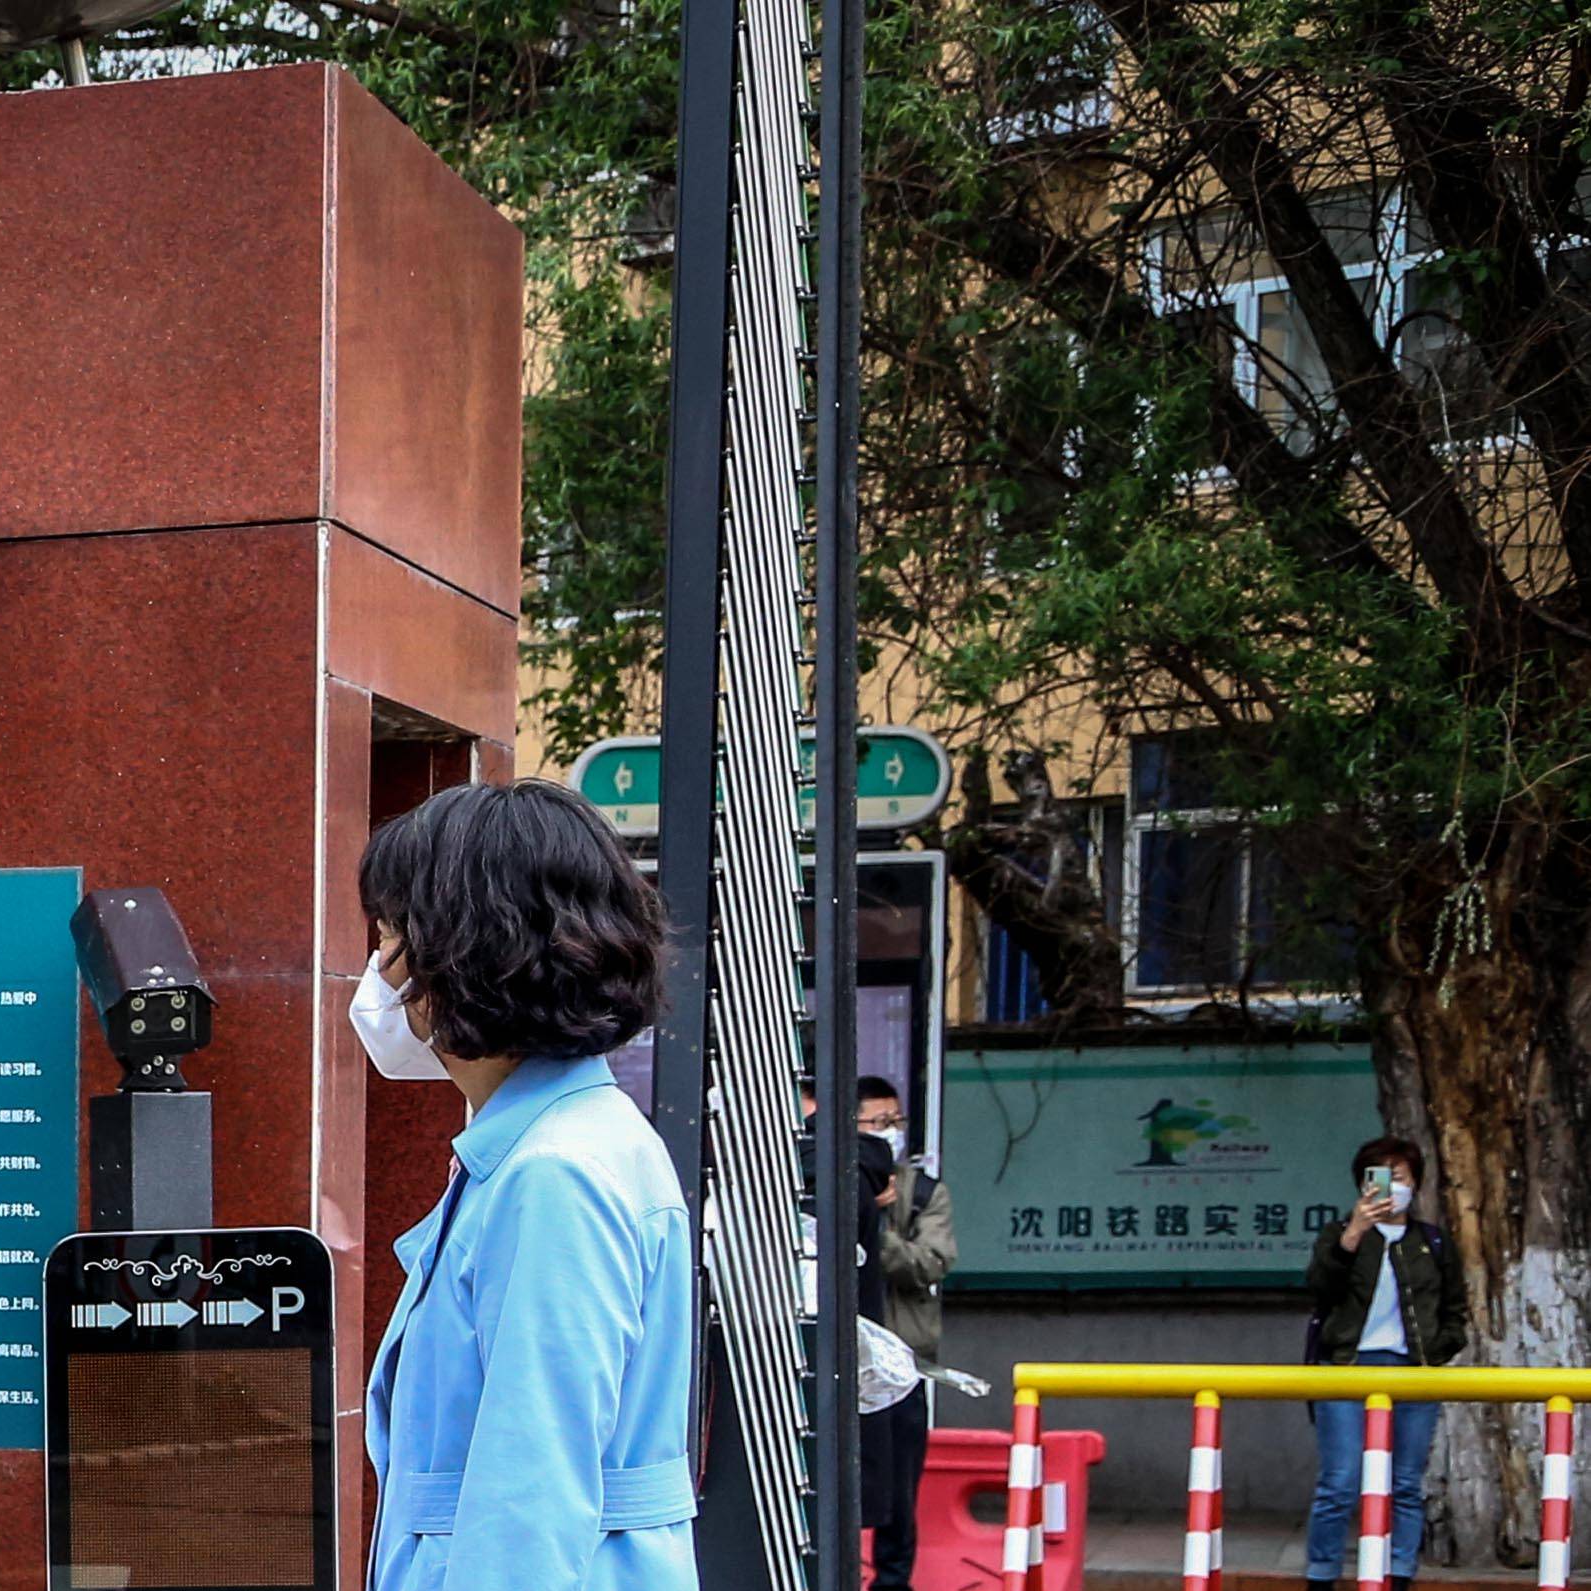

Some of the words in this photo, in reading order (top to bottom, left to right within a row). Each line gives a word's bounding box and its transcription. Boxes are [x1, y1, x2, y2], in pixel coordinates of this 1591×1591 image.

[1010, 1204, 1340, 1238] 沈阳铁路实验中
[182, 1262, 192, 1274] P
[272, 1286, 306, 1332] P
